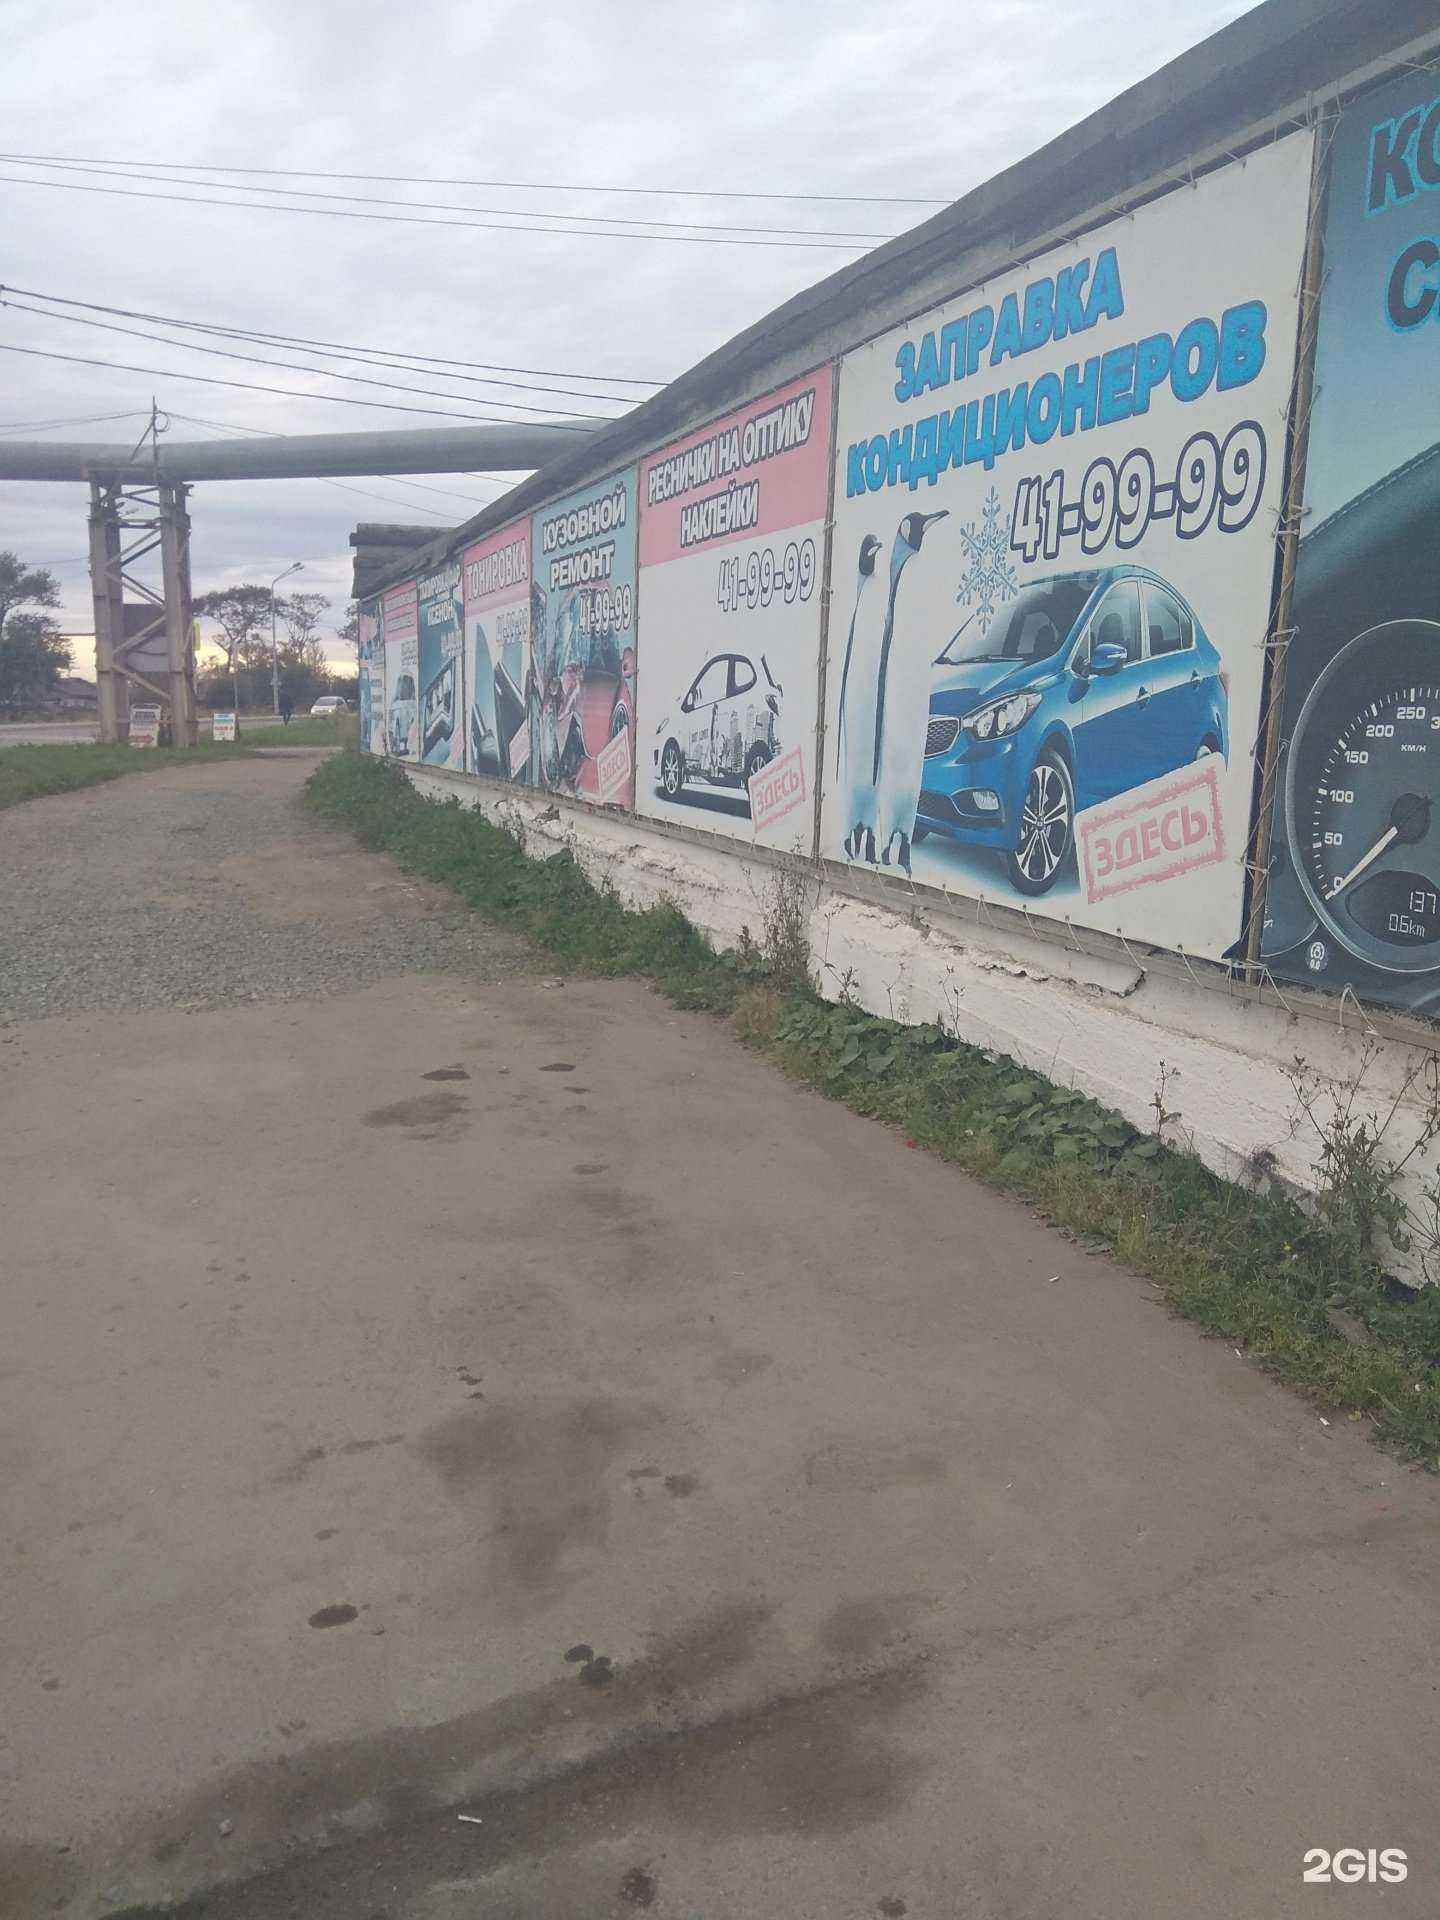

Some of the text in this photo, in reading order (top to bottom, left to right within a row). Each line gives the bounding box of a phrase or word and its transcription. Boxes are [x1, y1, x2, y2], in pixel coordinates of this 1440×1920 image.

[894, 246, 1125, 402] ЗАПРАВКА
[846, 299, 1268, 498] КОНДИЦИОНЕРОВ
[648, 388, 816, 507] РЕСНИЧКИ НА ОПТИКУ
[543, 481, 627, 555] КУЗОВНОЙ
[680, 478, 760, 548] НАКЛЕЙКИ
[1010, 420, 1267, 562] 41-99-99
[464, 536, 529, 601] ТОНИРОВКА
[550, 540, 615, 592] РЕМОНТ
[718, 538, 816, 612] 41-99-99
[579, 584, 632, 636] 41-99-99
[1365, 724, 1395, 738] 200
[1396, 706, 1426, 720] 250
[1344, 750, 1369, 764] 150
[1329, 790, 1354, 803] 100
[1089, 804, 1210, 877] ЗДЕСЬ
[1323, 832, 1343, 846] 50
